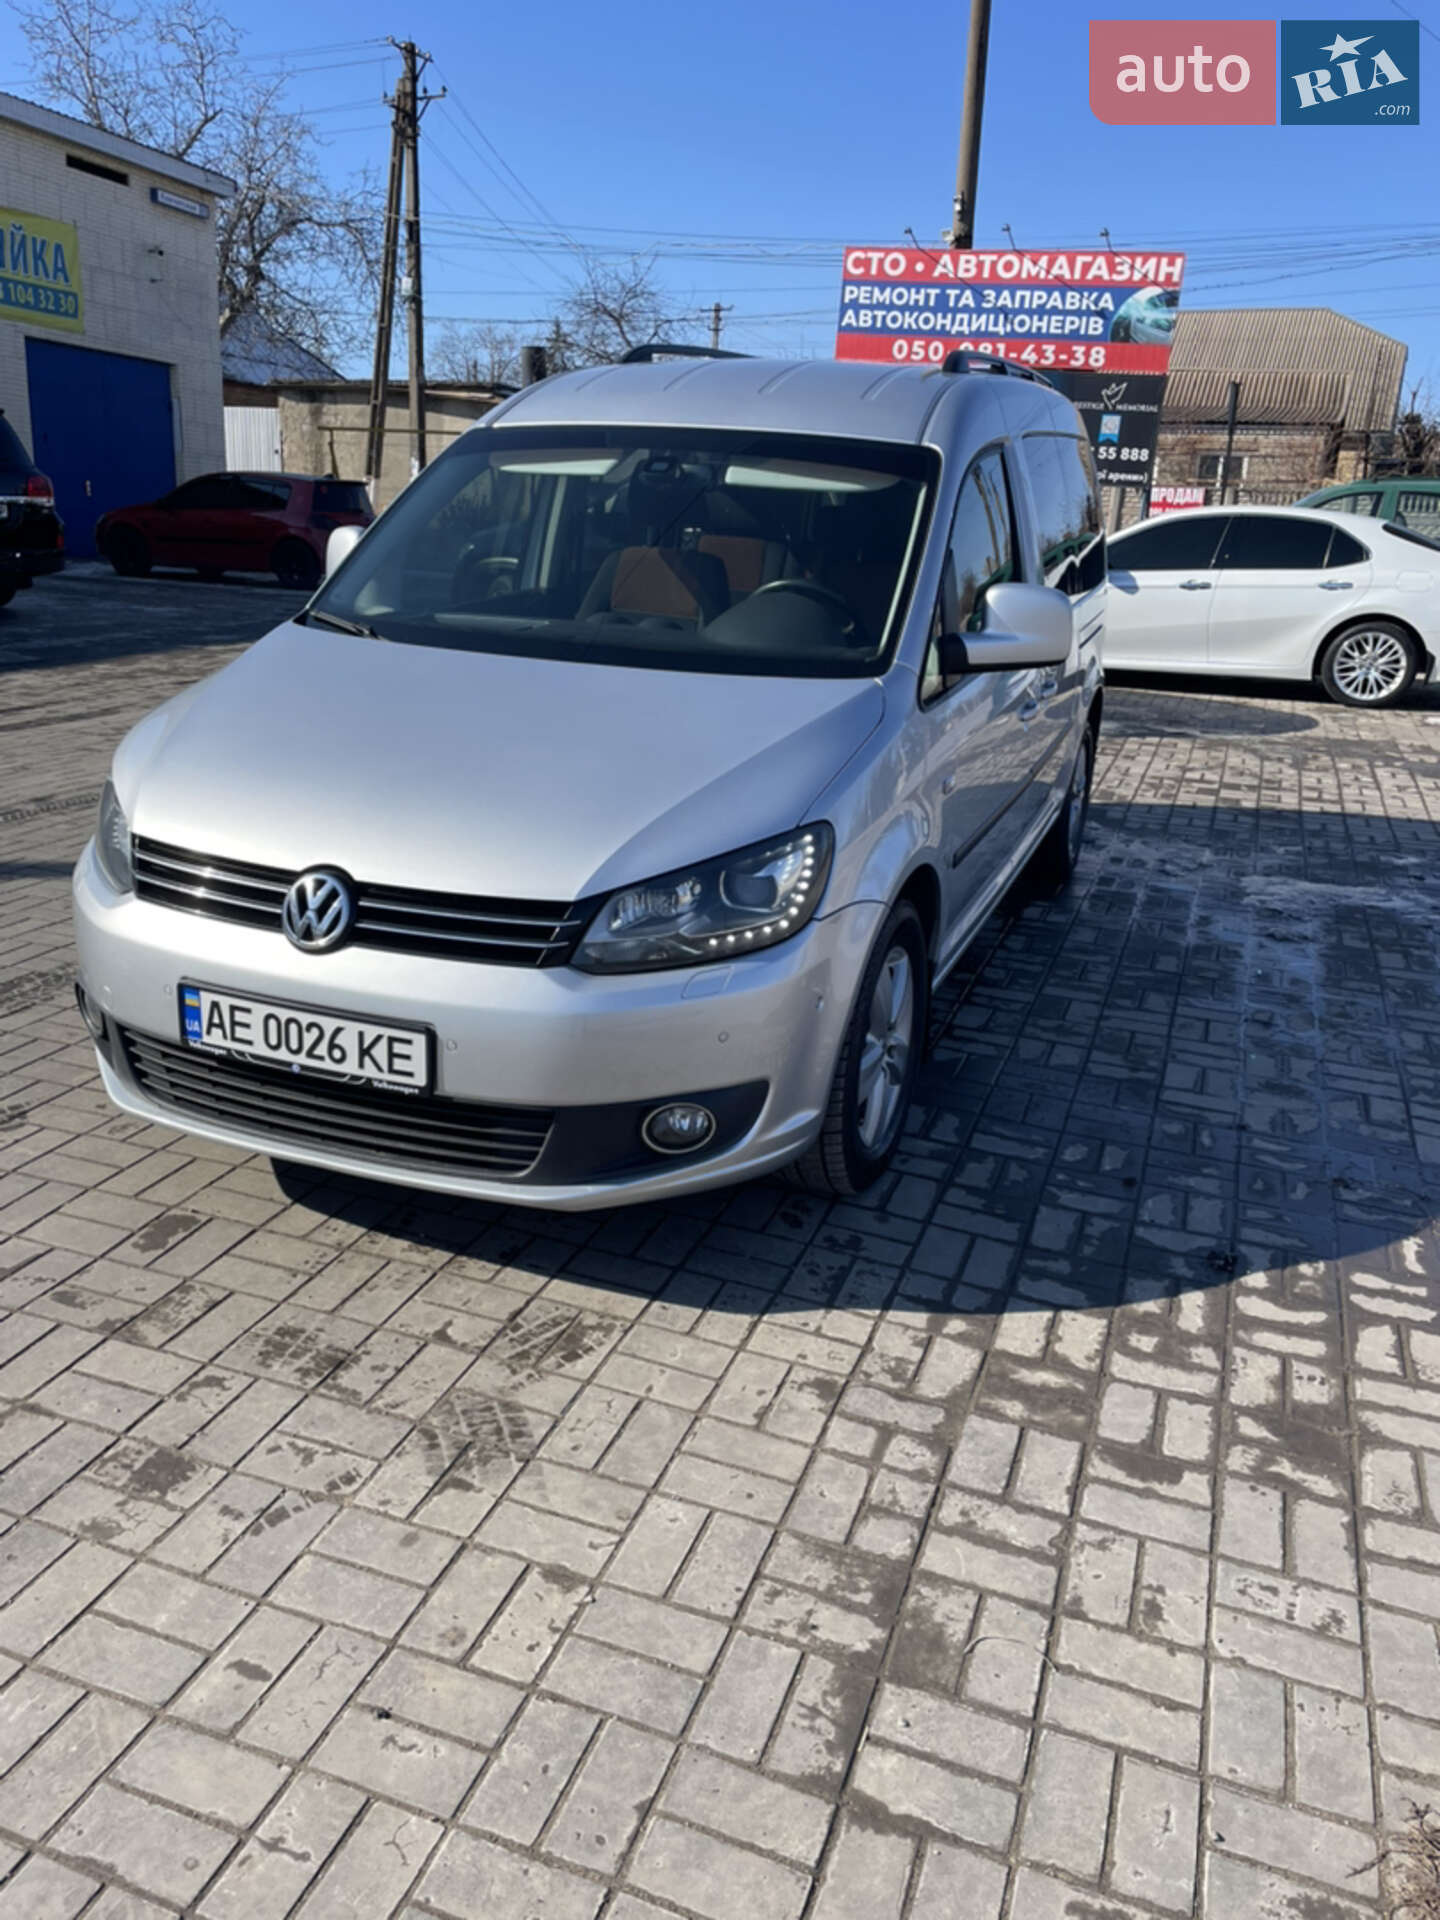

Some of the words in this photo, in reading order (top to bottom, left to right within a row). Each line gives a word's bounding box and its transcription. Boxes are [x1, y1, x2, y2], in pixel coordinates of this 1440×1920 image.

[845, 251, 907, 277] СТО
[933, 255, 1184, 282] АВТОМАГАЗИН
[8, 282, 34, 306] 104
[37, 288, 56, 311] 32
[58, 293, 76, 315] 30
[843, 286, 940, 307] РЕМОНТ
[946, 290, 975, 308] ТА
[982, 291, 1115, 312] ЗАПРАВКА
[841, 308, 1104, 335] АВТОКОНДИЦІОНЕРІВ
[1097, 446, 1117, 460] 55
[1120, 447, 1150, 462] 888
[185, 1018, 200, 1032] UA
[205, 1000, 253, 1047] AE
[263, 1013, 347, 1065] 0026
[357, 1031, 415, 1078] KE
